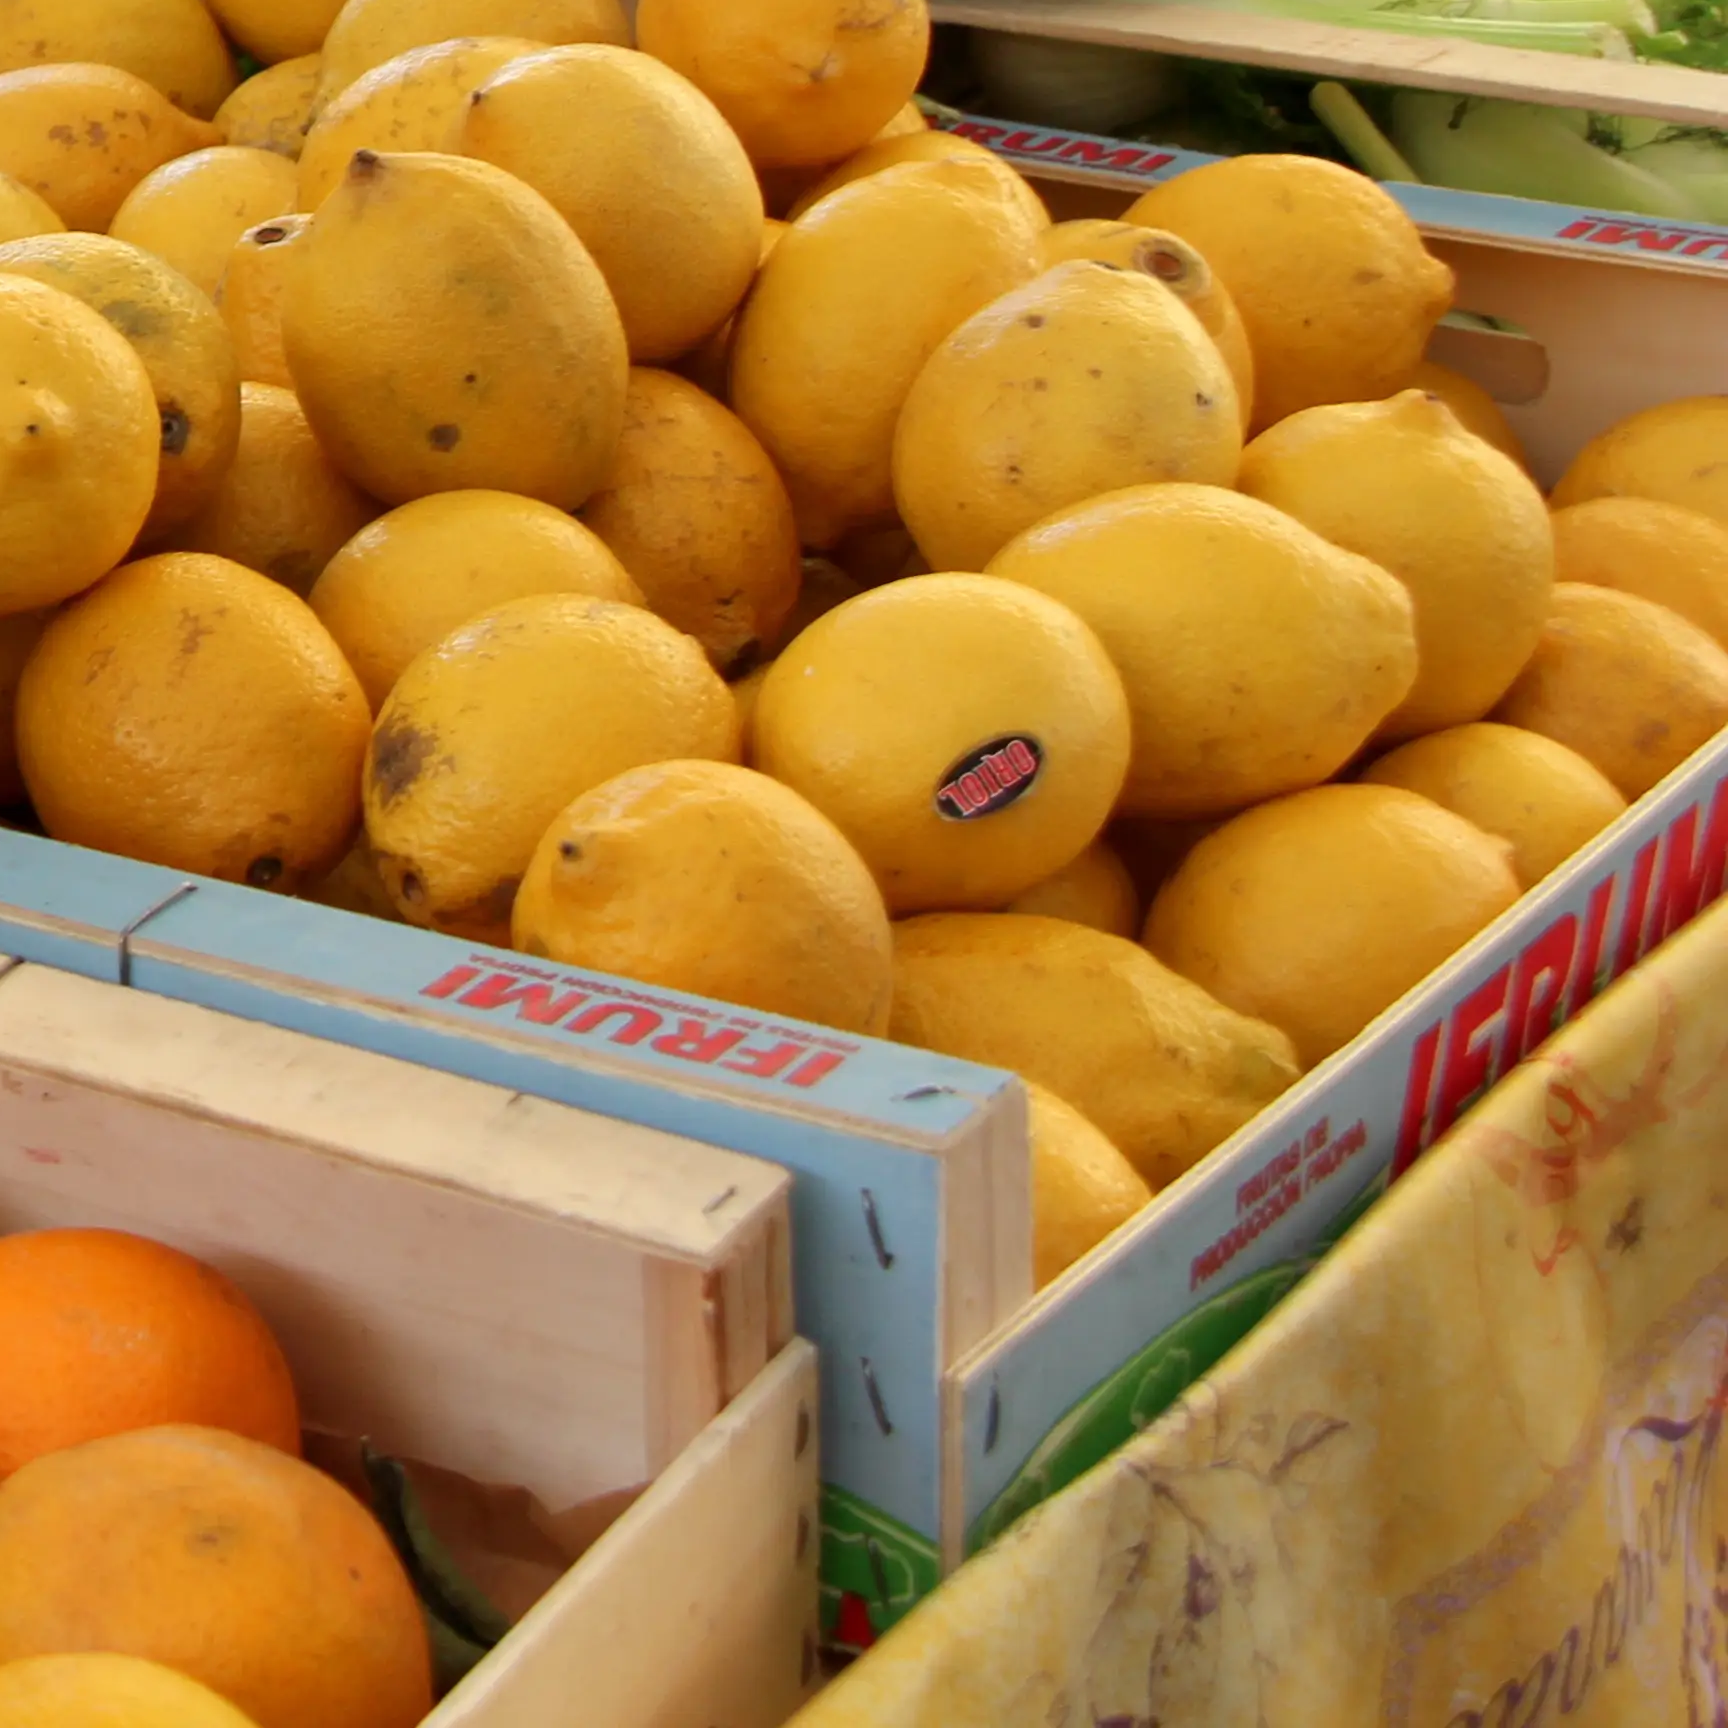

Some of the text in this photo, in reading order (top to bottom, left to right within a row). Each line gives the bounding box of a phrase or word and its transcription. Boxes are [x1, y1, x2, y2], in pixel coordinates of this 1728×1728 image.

[949, 121, 1177, 172] RUMI
[939, 739, 1037, 817] ORIOL
[417, 964, 847, 1088] IFRUMI
[1236, 1115, 1329, 1217] FRUTAS DE
[1306, 1117, 1367, 1193] PROPIA
